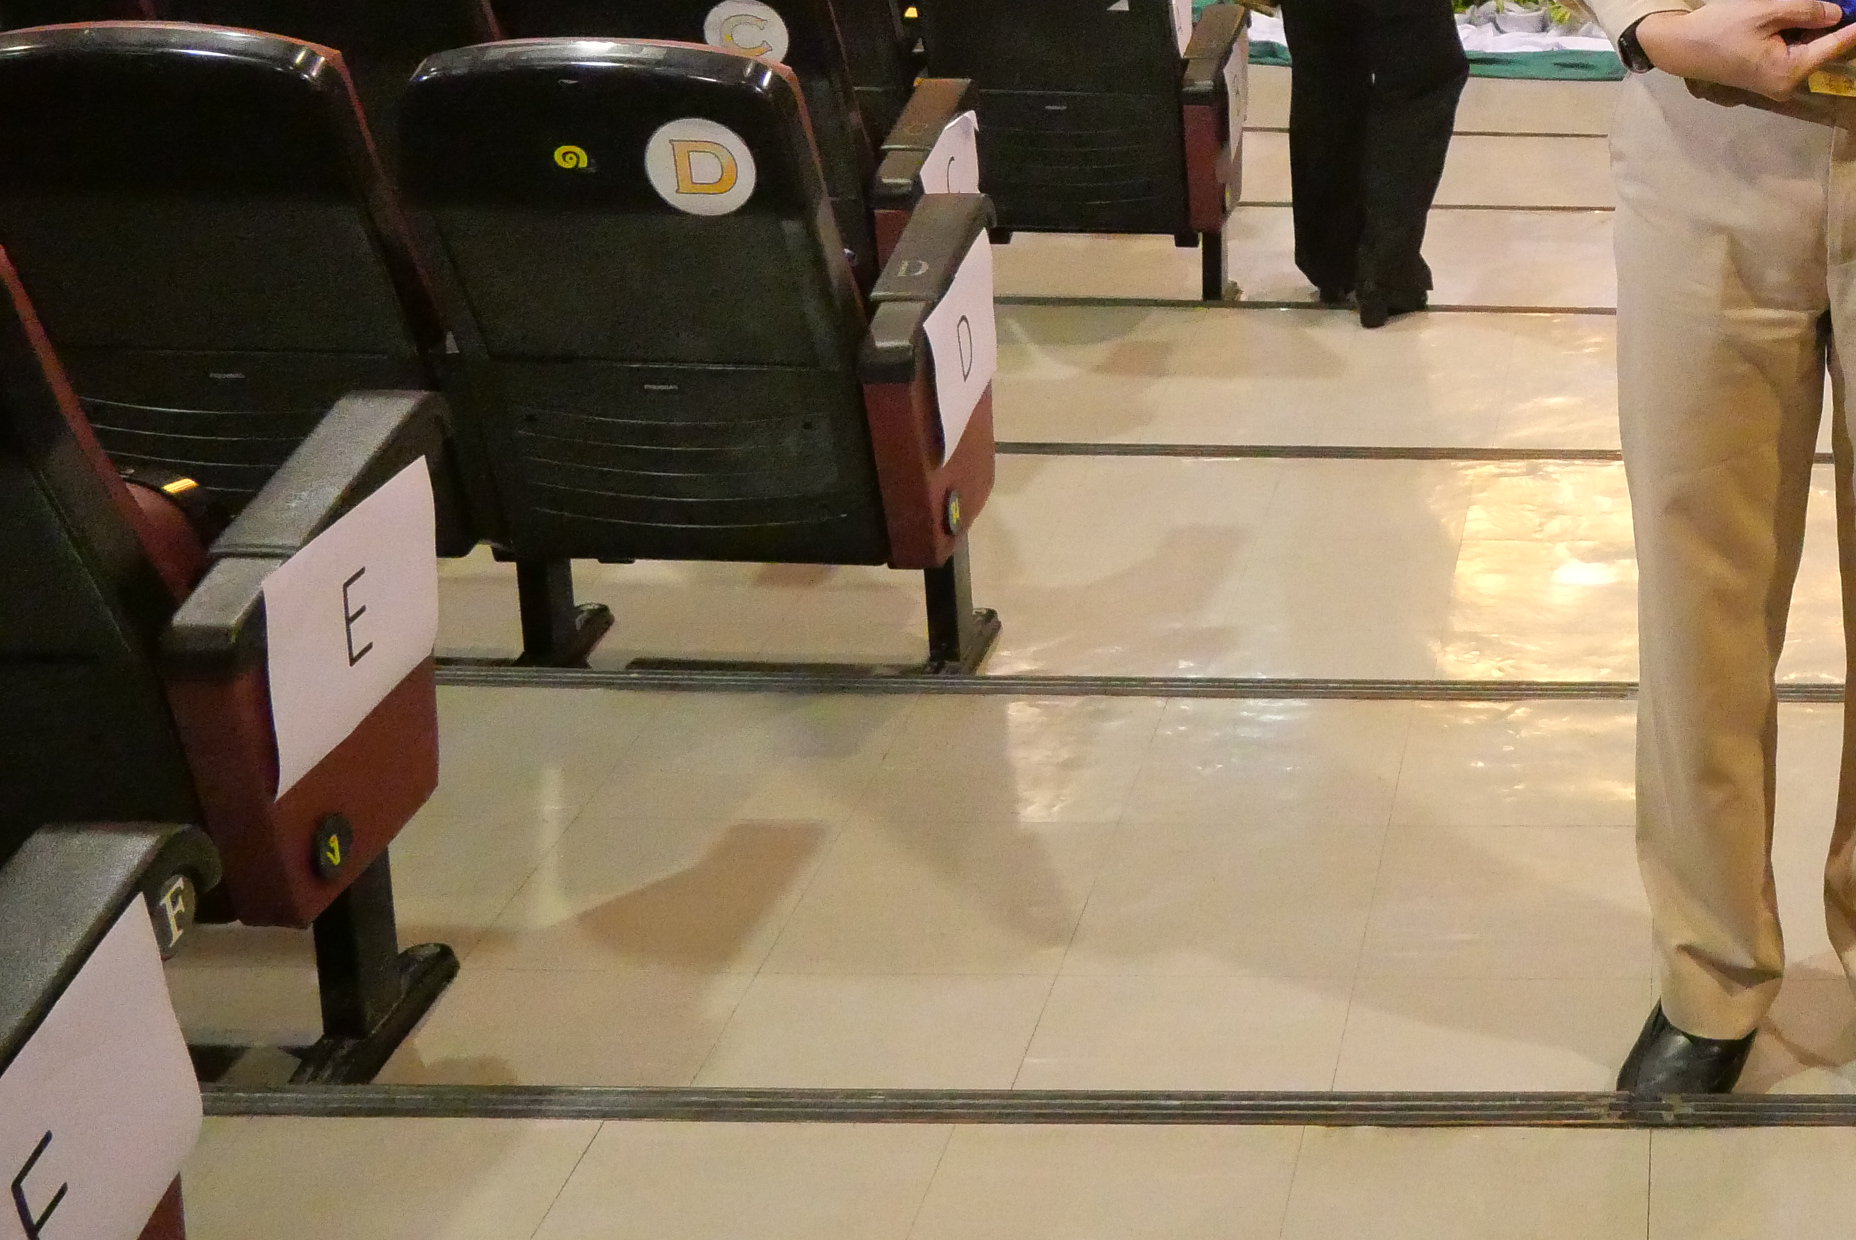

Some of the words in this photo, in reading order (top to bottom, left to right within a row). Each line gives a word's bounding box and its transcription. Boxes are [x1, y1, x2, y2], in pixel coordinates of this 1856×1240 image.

[719, 13, 773, 57] C
[668, 139, 738, 195] D
[896, 259, 929, 277] D
[956, 314, 973, 383] D
[342, 565, 374, 668] E
[159, 876, 186, 949] F
